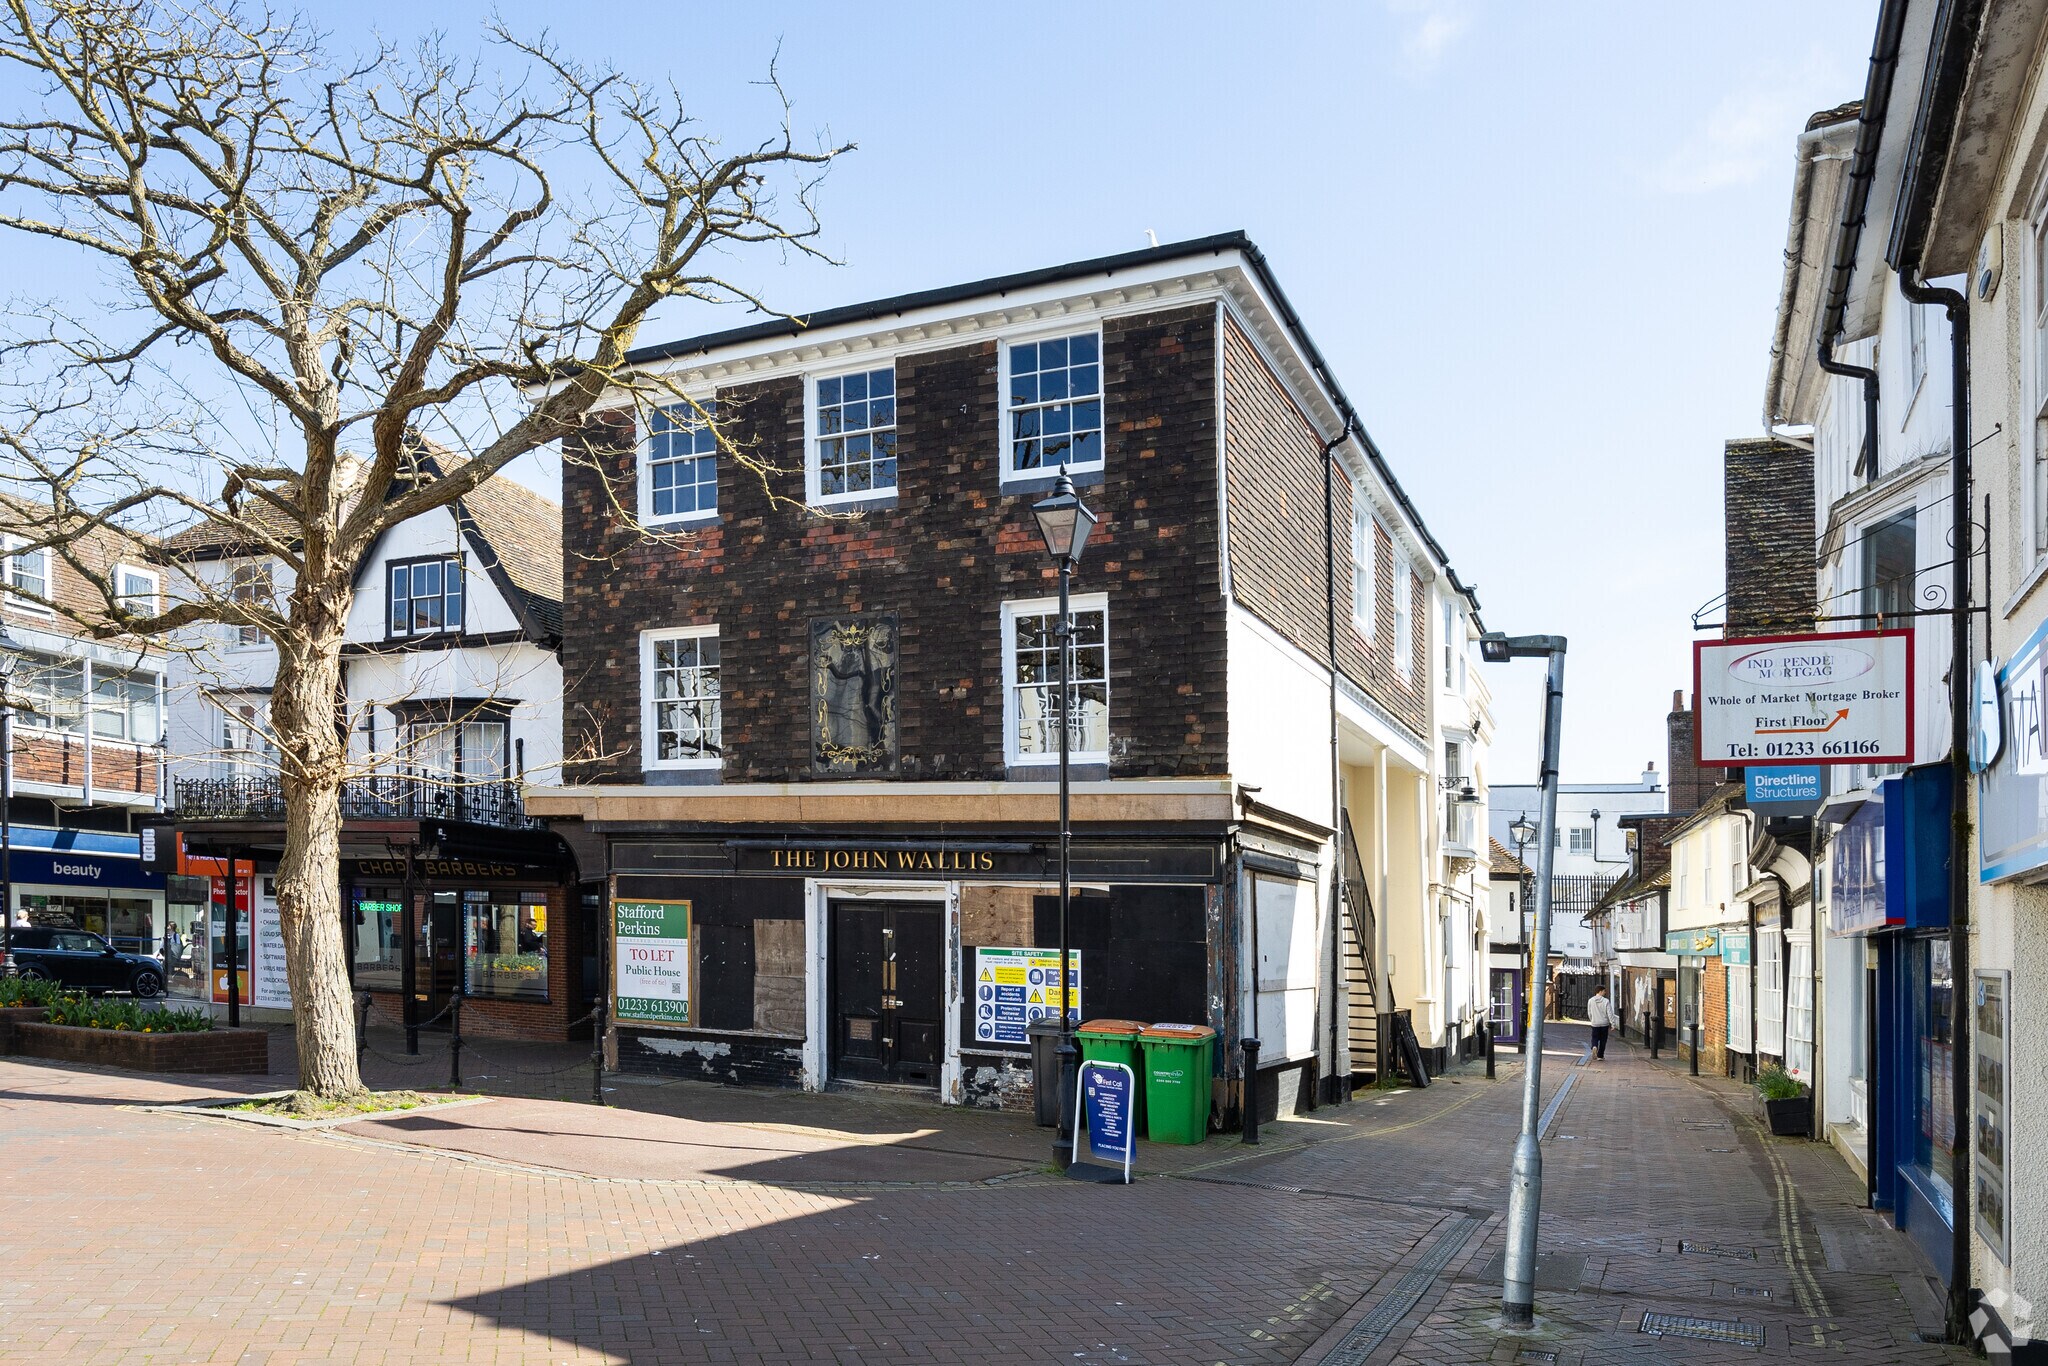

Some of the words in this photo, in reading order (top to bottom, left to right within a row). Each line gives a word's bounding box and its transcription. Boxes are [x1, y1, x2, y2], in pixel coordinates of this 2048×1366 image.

[1708, 696, 1741, 706] Whole
[1745, 695, 1756, 704] of
[1761, 693, 1799, 703] Market
[1805, 692, 1857, 702] Mortgage
[1862, 689, 1901, 699] Broker
[1755, 717, 1786, 727] First
[1793, 715, 1827, 726] Floor
[1727, 743, 1759, 757] Tel:
[1766, 741, 1814, 756] 01233
[1822, 739, 1880, 755] 661166
[1755, 774, 1816, 786] Directline
[1755, 786, 1817, 798] Structures
[770, 850, 816, 867] THE
[823, 851, 888, 871] JOHN
[897, 851, 993, 870] WALLIS
[53, 861, 101, 879] beauty
[358, 861, 419, 875] CHAP
[425, 861, 517, 876] BARBERS
[217, 879, 226, 887] You
[360, 902, 385, 911] BARBER
[617, 905, 664, 919] Stafford
[617, 921, 660, 935] Perkins
[630, 948, 648, 960] TO
[651, 949, 674, 961] LET
[357, 962, 401, 972] BARBERS
[625, 964, 651, 976] Public
[654, 966, 680, 978] House
[482, 970, 531, 980] BARBERS
[618, 998, 648, 1011] 01233
[651, 1000, 688, 1013] 613900
[618, 1011, 689, 1021] www.staffordperkins.co.uk
